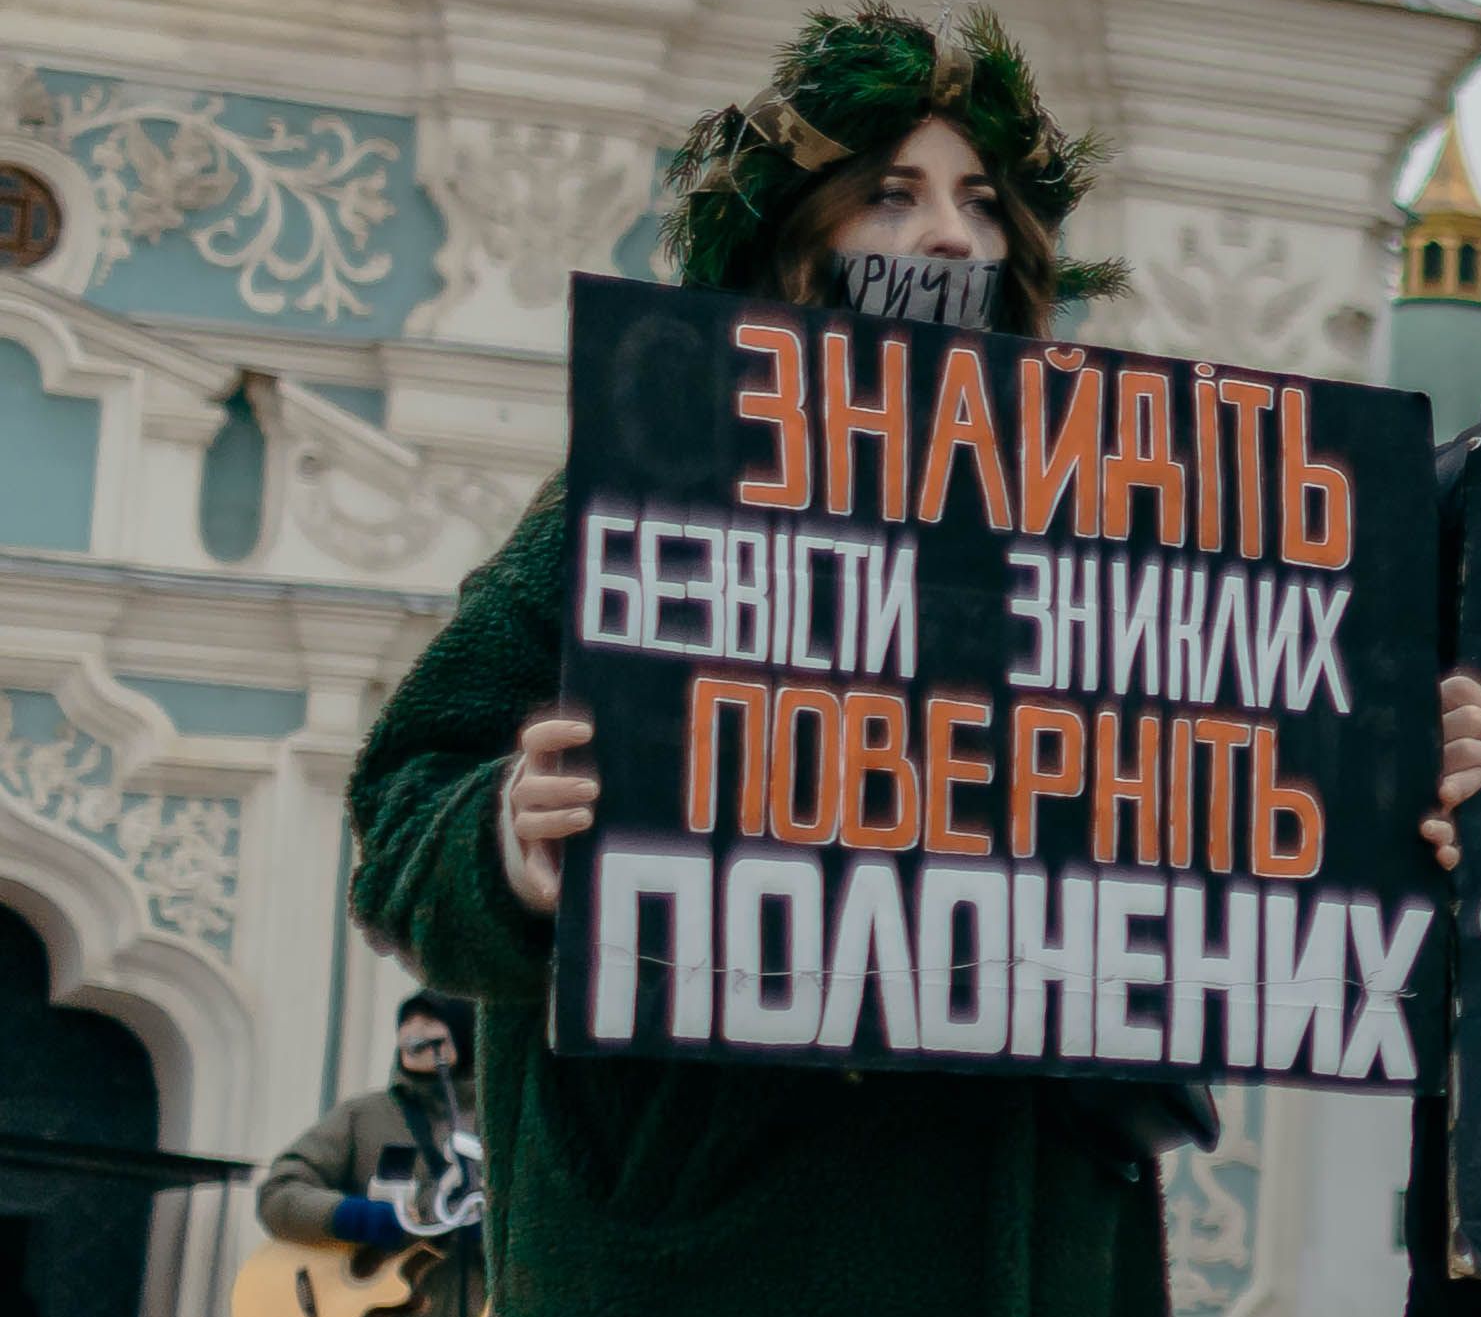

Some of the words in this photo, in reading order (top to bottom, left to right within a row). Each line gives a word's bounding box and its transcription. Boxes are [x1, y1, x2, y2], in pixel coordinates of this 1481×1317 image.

[734, 324, 1352, 571] ЗНАЙДІТЬ
[582, 512, 917, 678] БЕЗВІСТИ
[1007, 552, 1351, 714] ЗНИКЛИХ
[688, 677, 1325, 878] ПОВЕРНІТЬ
[592, 851, 1435, 1081] ПОЛОНЕНИХ
